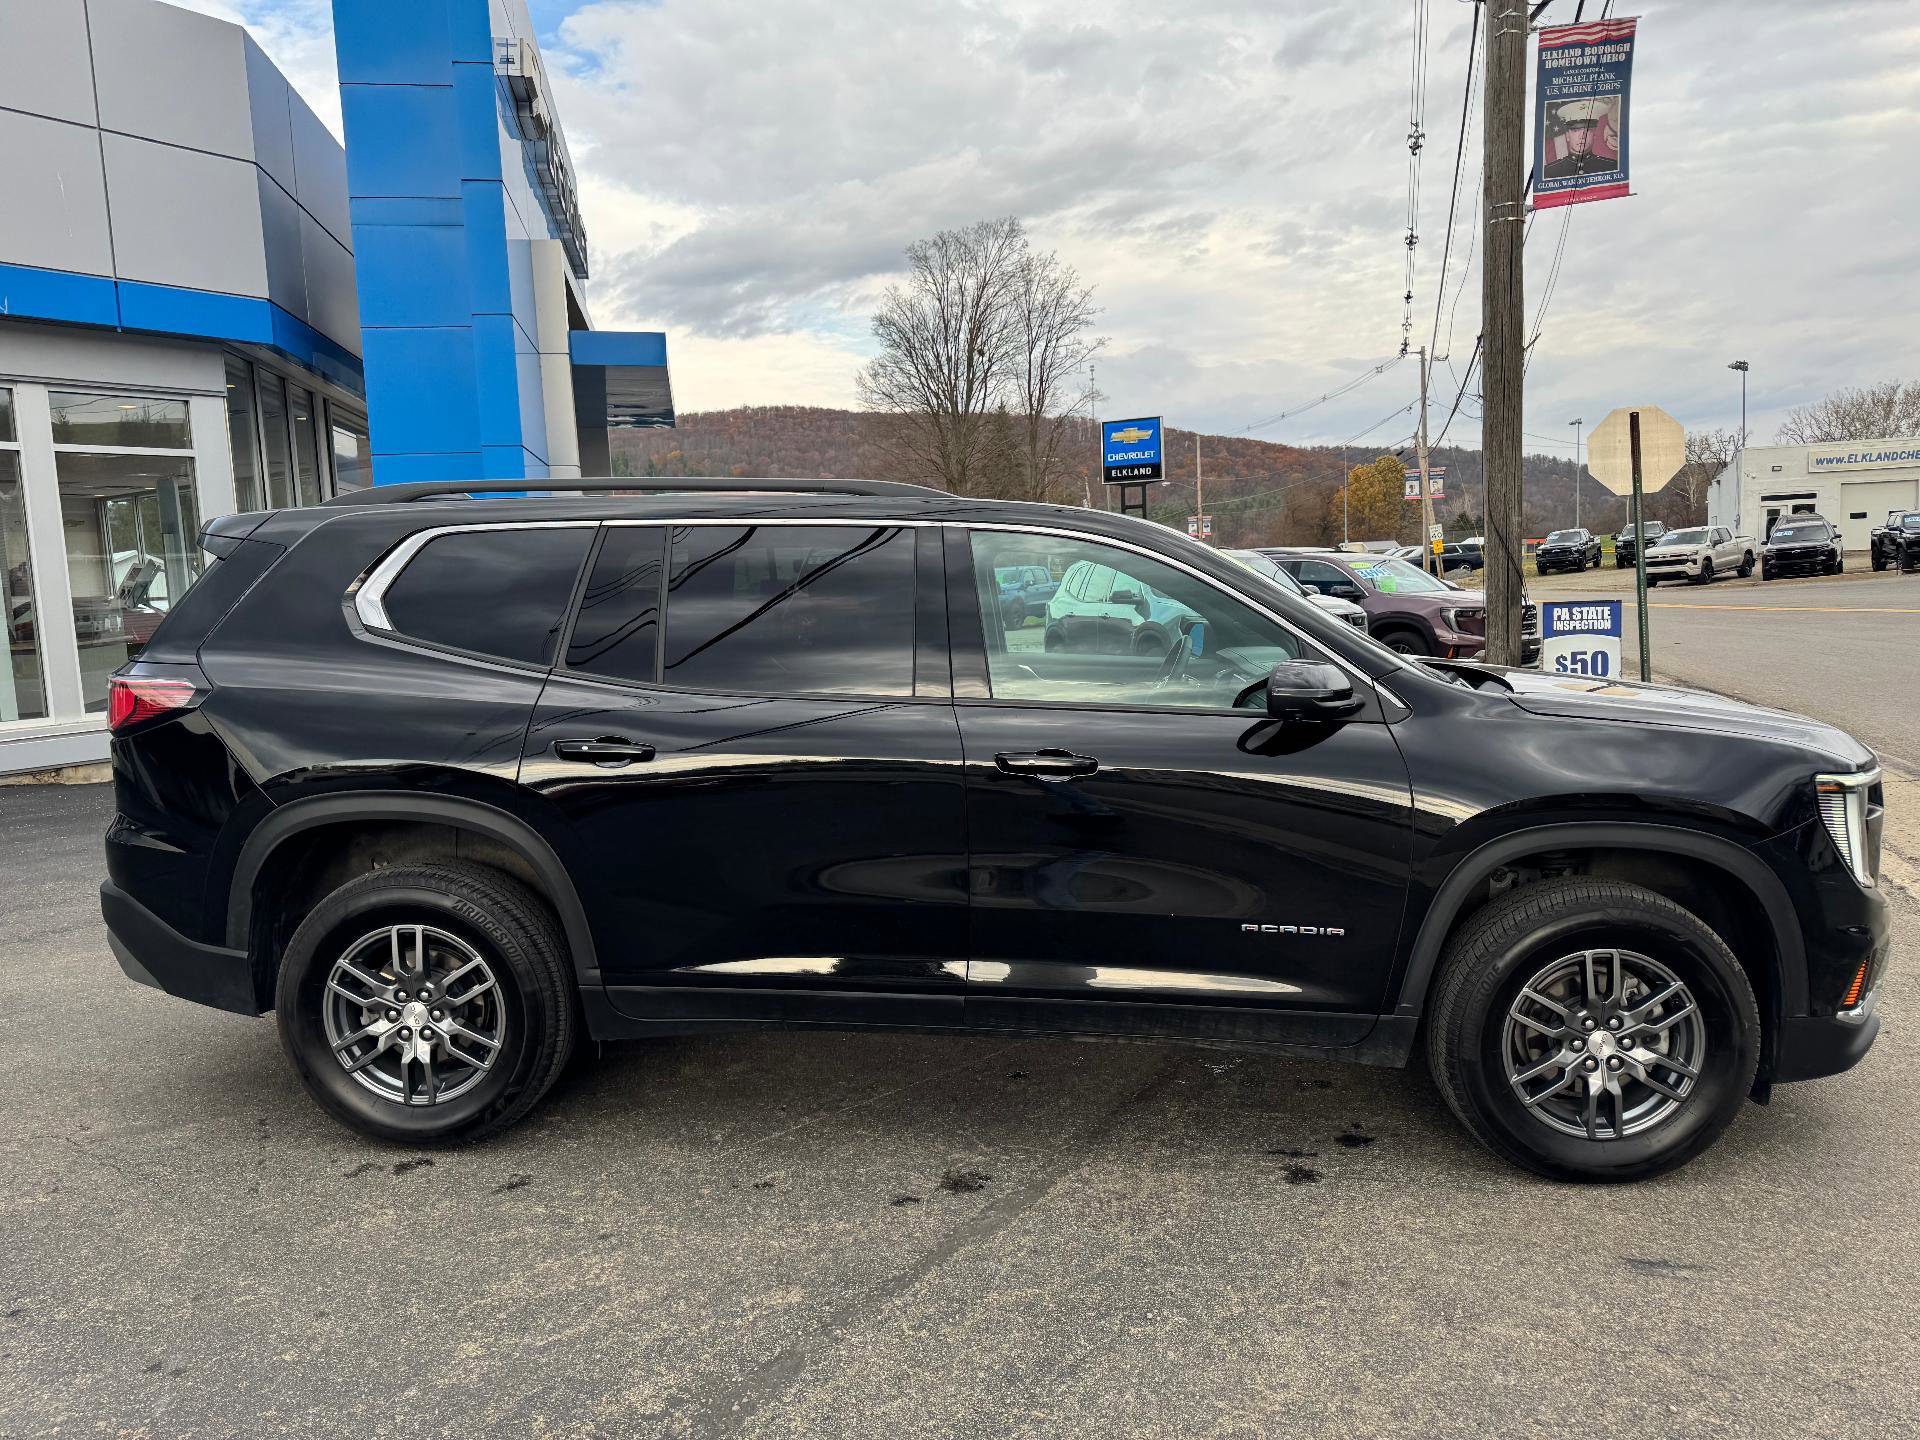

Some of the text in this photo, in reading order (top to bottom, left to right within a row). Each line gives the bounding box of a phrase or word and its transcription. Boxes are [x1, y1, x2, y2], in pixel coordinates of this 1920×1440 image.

[1542, 48, 1581, 60] ELKLAND
[1545, 55, 1597, 69] HOMETOWN
[1552, 75, 1589, 85] MICHAEL
[1561, 84, 1593, 94] MARINE
[1107, 450, 1156, 462] CHEVROLET
[1111, 467, 1152, 477] ELKLAND
[1553, 606, 1611, 621] PA STATE
[1553, 619, 1612, 631] INSPECTION
[1555, 650, 1609, 678] $50
[1241, 923, 1345, 937] ACADIA
